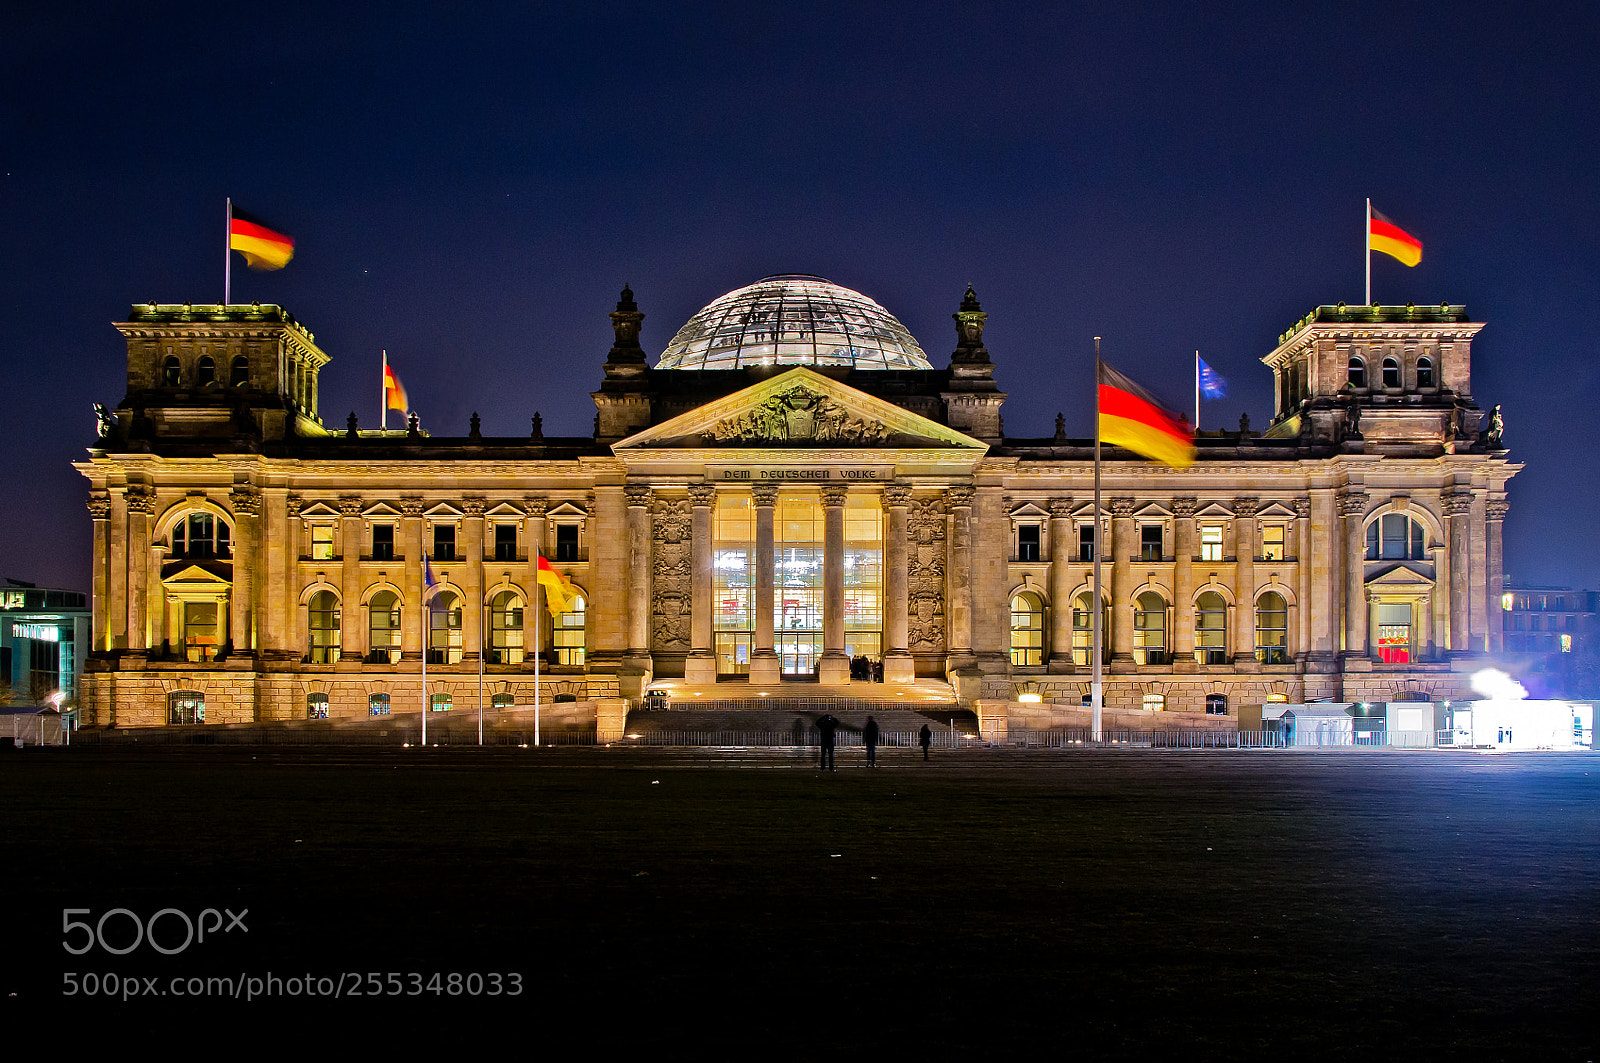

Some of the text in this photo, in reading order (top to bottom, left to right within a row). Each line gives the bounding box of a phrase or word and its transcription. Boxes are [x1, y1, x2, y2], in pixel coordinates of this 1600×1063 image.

[724, 470, 877, 479] DEM DEUTSCHEN VOLKE
